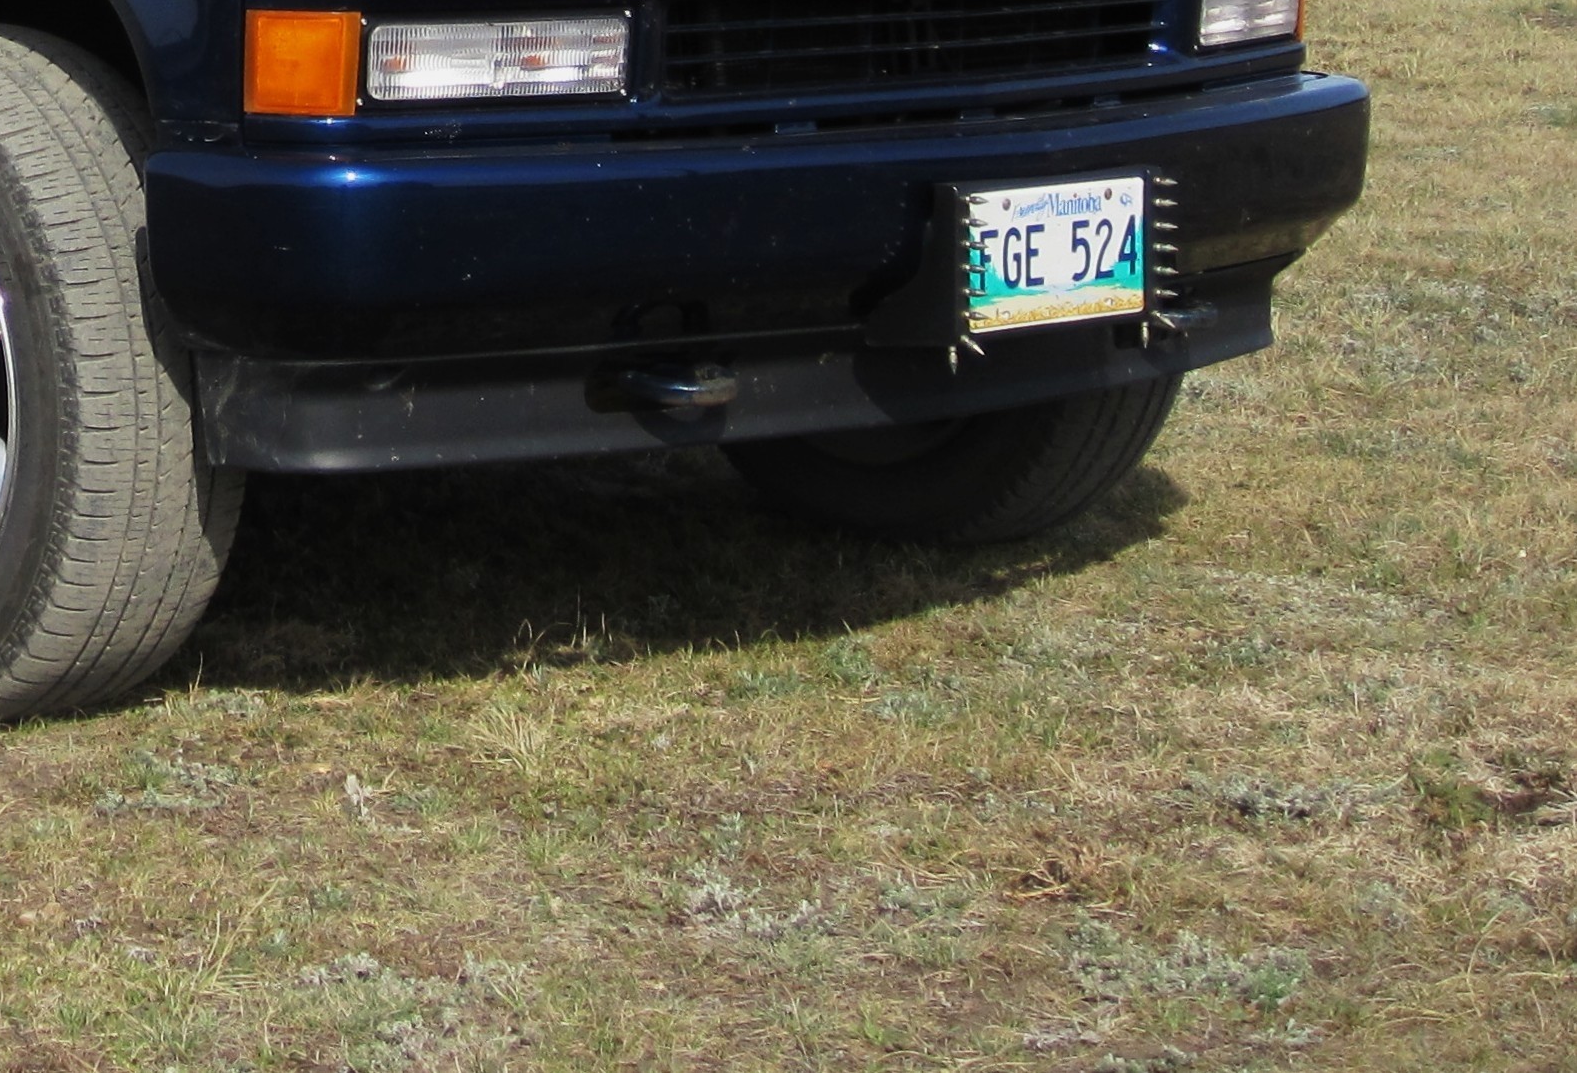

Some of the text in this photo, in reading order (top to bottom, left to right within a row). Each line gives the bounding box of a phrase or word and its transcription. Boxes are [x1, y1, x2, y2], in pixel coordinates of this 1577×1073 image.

[1047, 192, 1102, 218] Manitoba
[979, 214, 1137, 293] FGE 524
